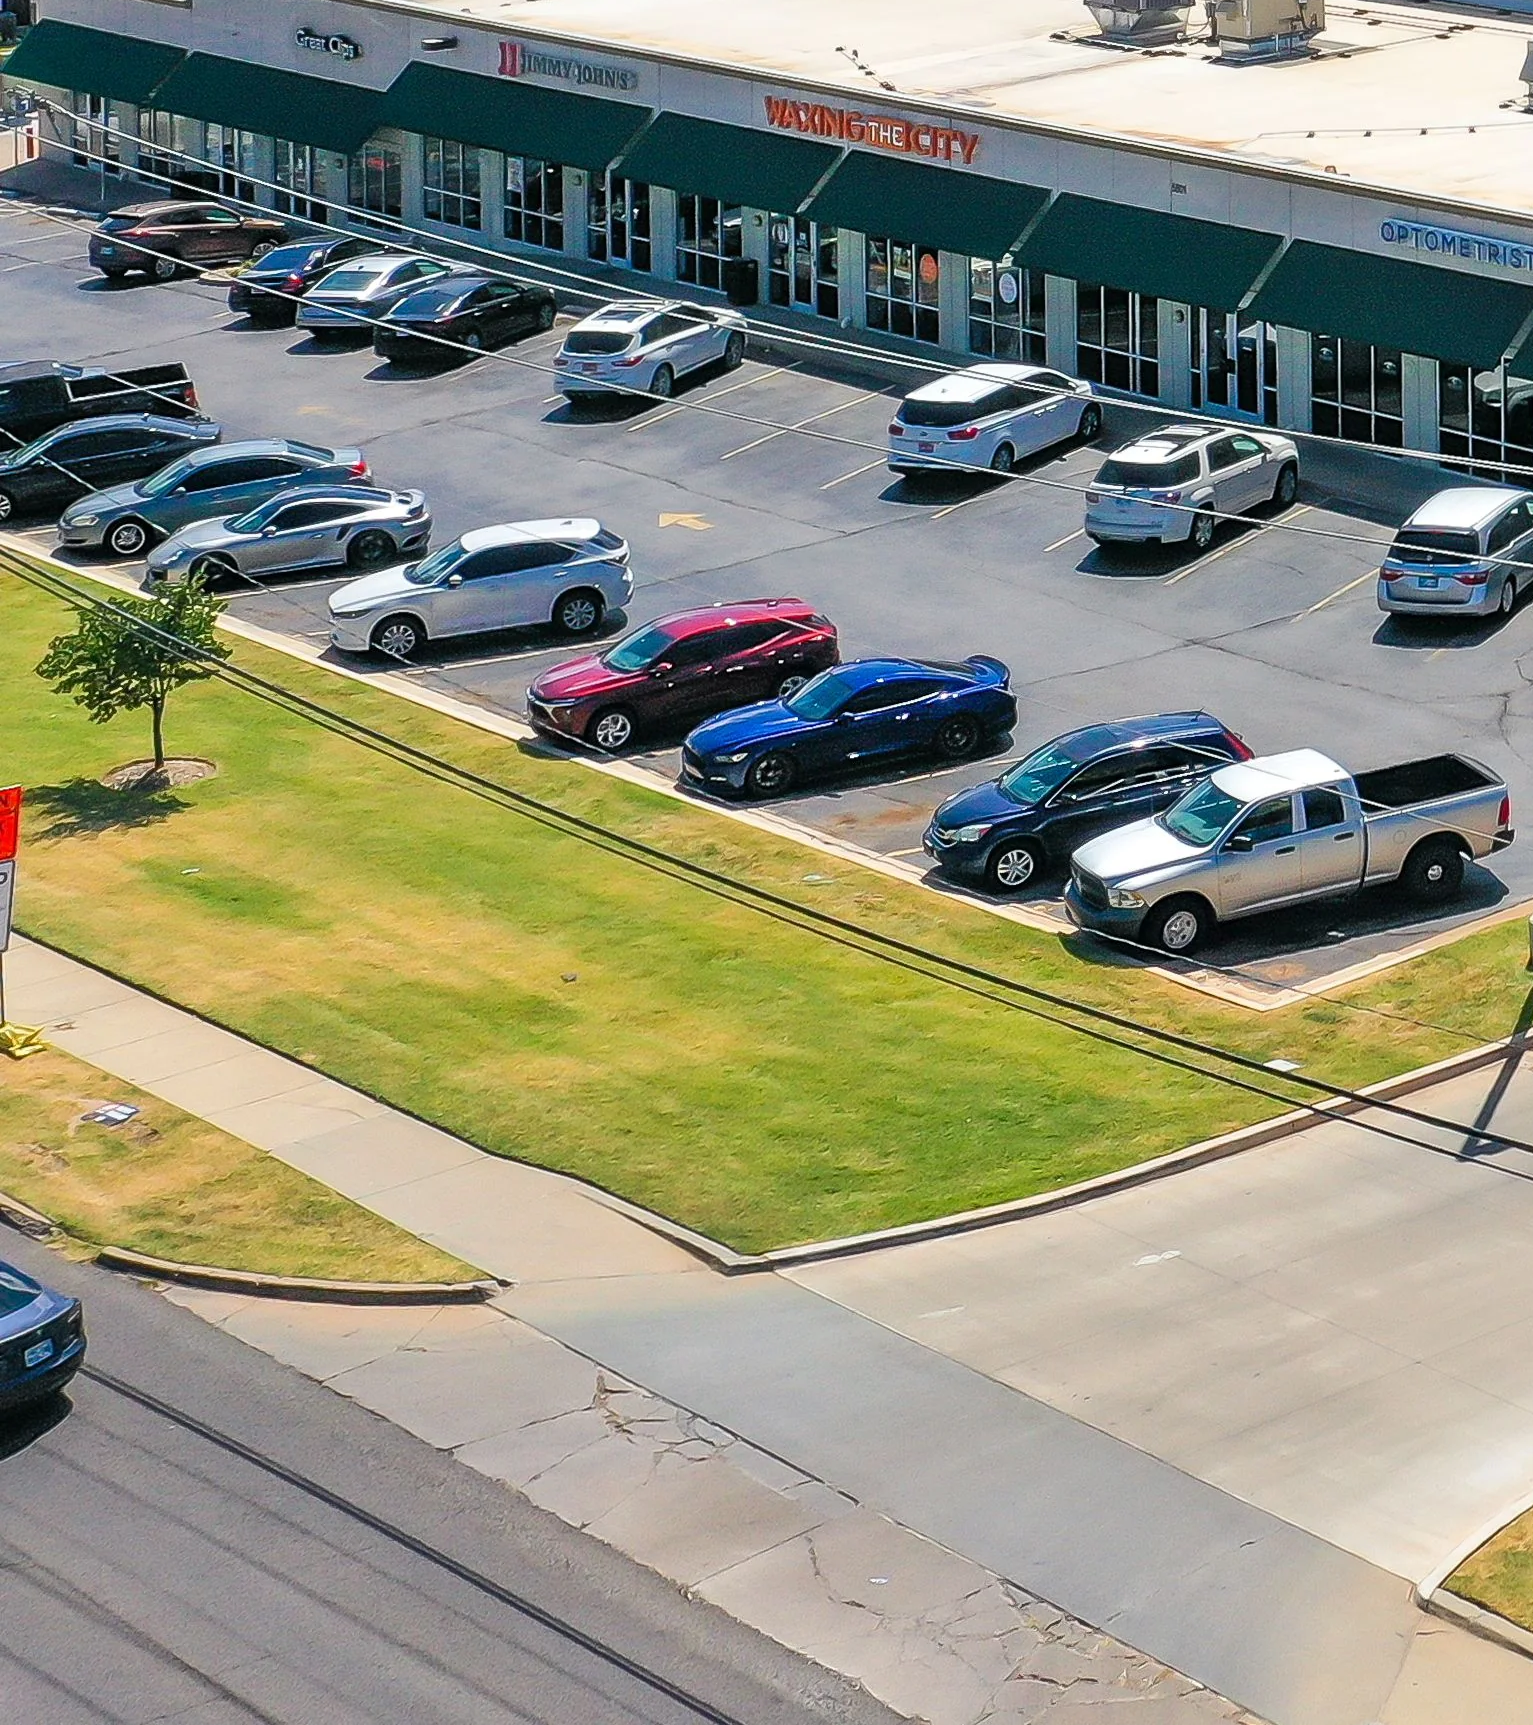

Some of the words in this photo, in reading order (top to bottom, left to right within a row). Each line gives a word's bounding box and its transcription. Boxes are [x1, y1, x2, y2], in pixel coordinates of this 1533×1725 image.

[521, 52, 572, 79] JIMMY
[574, 63, 638, 91] JOHN'S
[764, 95, 864, 143] WAXING
[868, 120, 904, 147] THE
[911, 124, 979, 165] CITY
